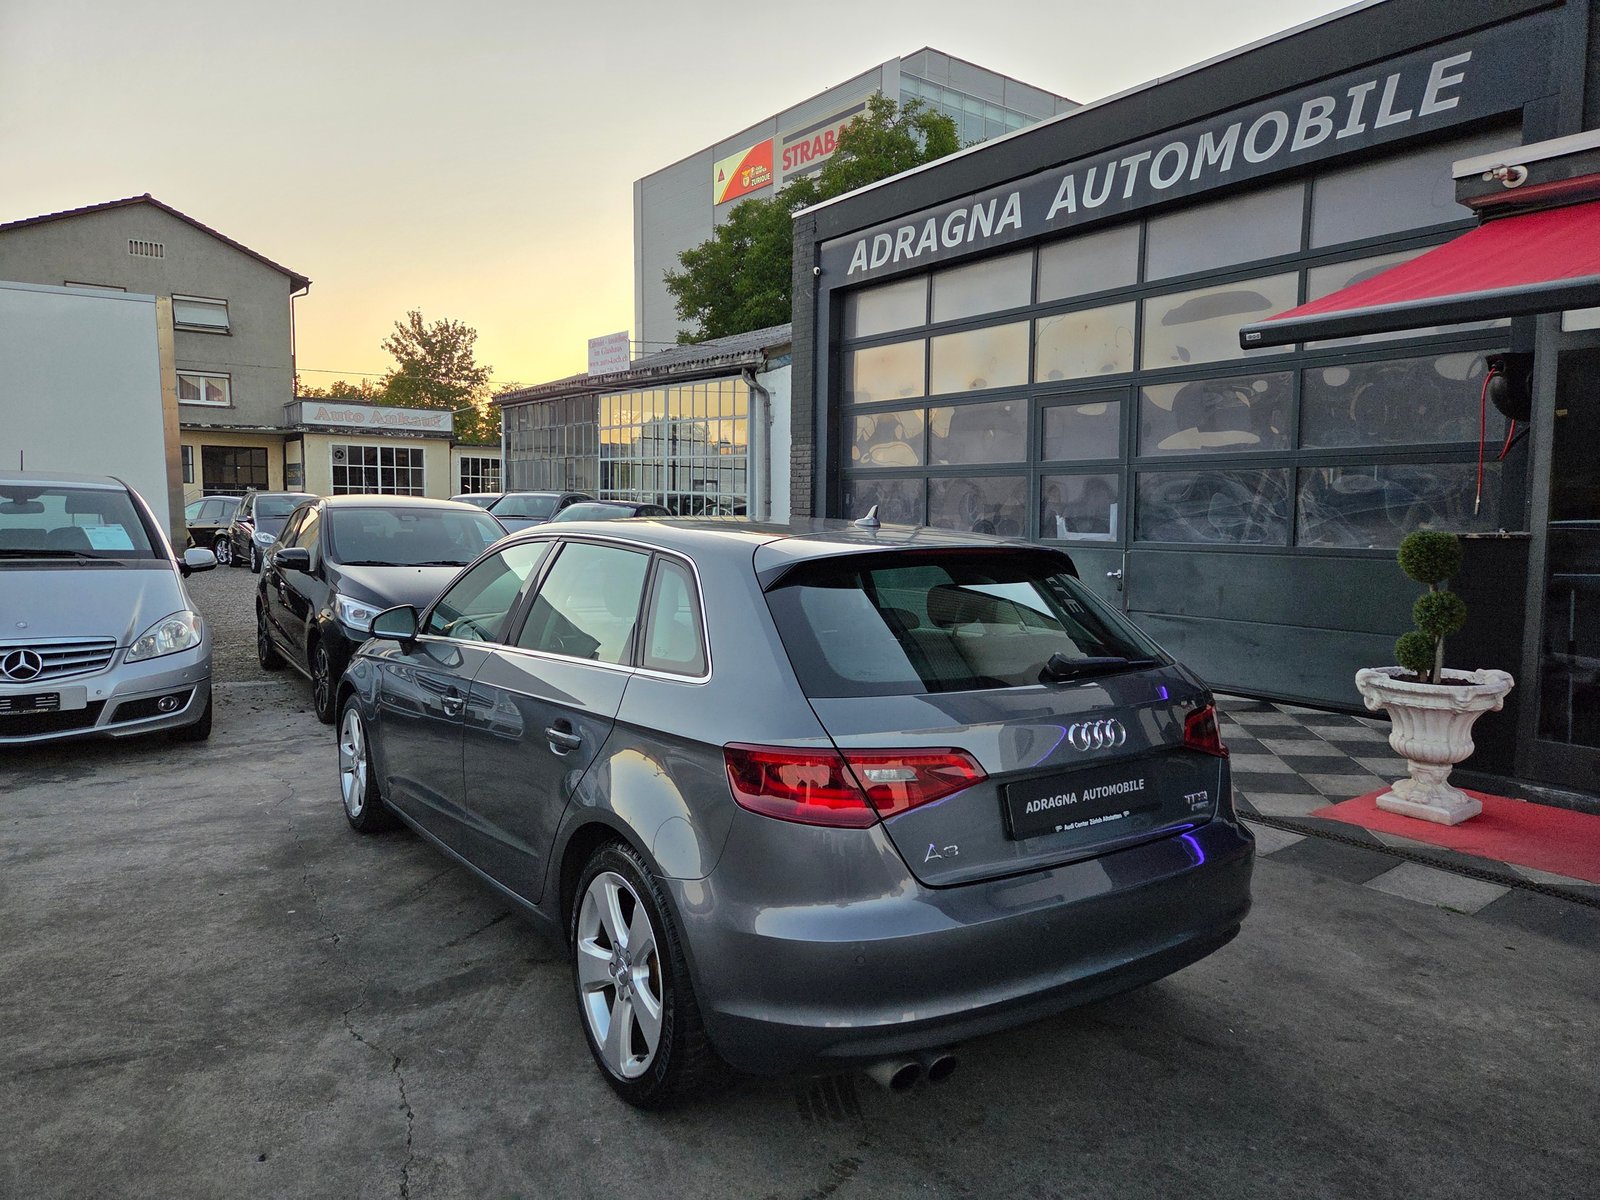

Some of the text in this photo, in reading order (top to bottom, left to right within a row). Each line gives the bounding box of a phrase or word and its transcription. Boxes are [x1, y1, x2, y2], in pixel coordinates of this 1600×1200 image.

[848, 50, 1473, 276] ADRAGNA AUTOMOBILE
[314, 407, 441, 427] Auto Ankauf
[1025, 778, 1145, 814] ADRAGNA AUTOMOBILE
[924, 843, 959, 863] A3
